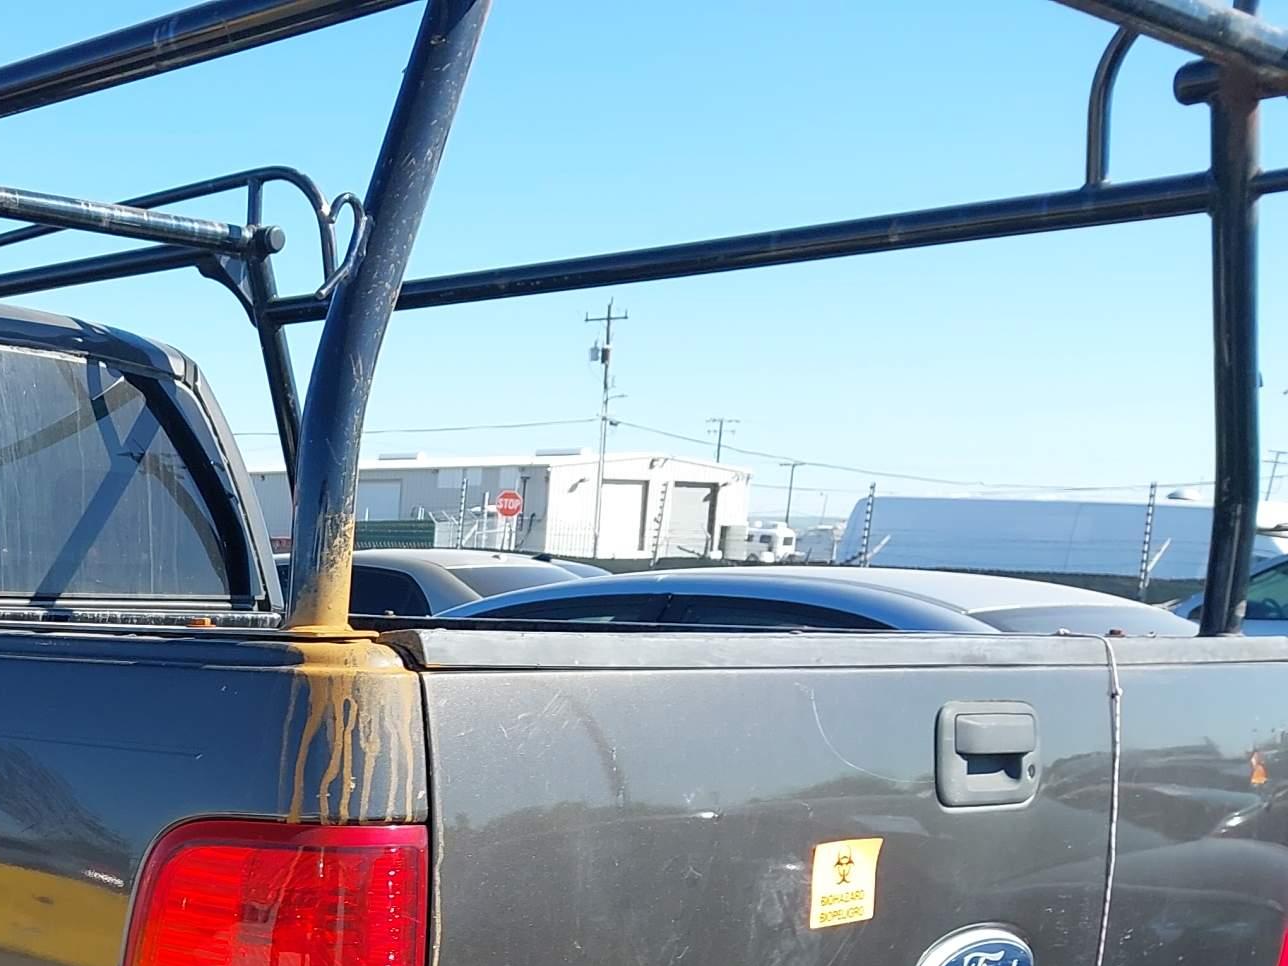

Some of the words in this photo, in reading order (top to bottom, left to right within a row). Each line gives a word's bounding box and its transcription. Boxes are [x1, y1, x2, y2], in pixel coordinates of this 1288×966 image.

[496, 498, 521, 510] STOP
[820, 889, 865, 907] BIOHAZARD
[819, 905, 865, 924] BIOPELIGRO
